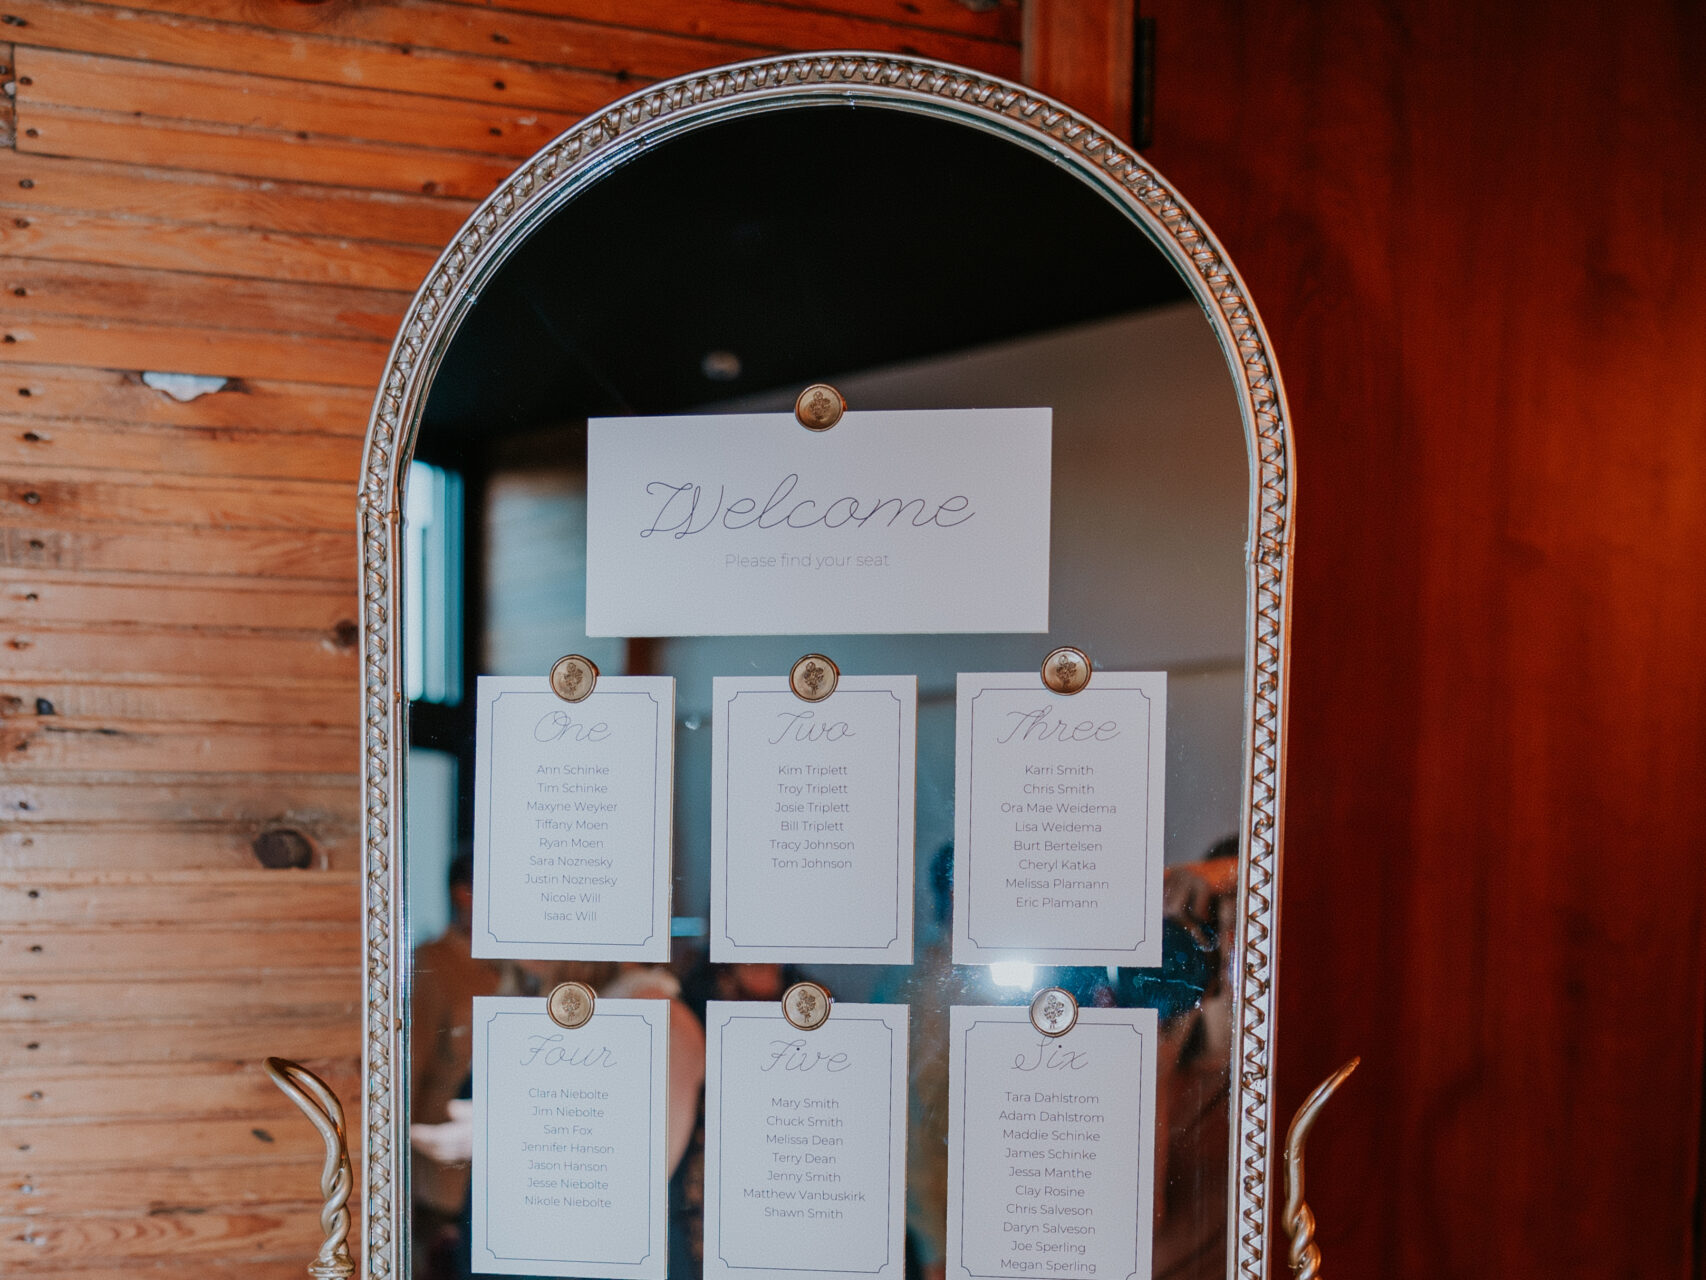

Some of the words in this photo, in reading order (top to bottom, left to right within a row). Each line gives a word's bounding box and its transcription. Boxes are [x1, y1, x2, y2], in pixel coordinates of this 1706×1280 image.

[640, 473, 975, 539] Welcome
[725, 553, 776, 568] Please
[781, 553, 812, 568] find
[815, 554, 852, 570] your
[856, 553, 889, 567] seat
[534, 710, 612, 742] One
[769, 710, 856, 744] Two
[997, 705, 1120, 744] Three
[537, 765, 560, 775] Ann
[564, 764, 609, 776] Schinke
[778, 765, 802, 776] Kim
[805, 764, 848, 778] Triplett
[1025, 765, 1053, 776] Karri
[1057, 764, 1094, 776] Smith
[778, 784, 802, 796] Troy
[806, 784, 848, 796] Triplett
[1024, 784, 1054, 795] Chris
[1058, 784, 1094, 794] Smith
[527, 802, 571, 814] Maxyne
[574, 802, 617, 814] Weyker
[776, 802, 804, 813] Josie
[808, 802, 850, 815] Triplett
[1001, 803, 1023, 813] Ora
[1027, 803, 1053, 813] Mae
[1057, 802, 1116, 814] Weidema
[536, 820, 572, 832] Tiffany
[576, 820, 608, 830] Moen
[781, 821, 798, 832] Bill
[802, 821, 844, 834] Triplett
[1015, 822, 1037, 833] Lisa
[1042, 821, 1102, 833] Weidema
[540, 838, 568, 850] Ryan
[572, 838, 604, 849] Moen
[770, 840, 800, 852] Tracy
[804, 840, 854, 850] Johnson
[530, 856, 554, 866] Sara
[558, 856, 612, 870] Noznesky
[772, 858, 798, 869] Tom
[802, 858, 852, 870] Johnson
[1019, 859, 1058, 872] Cheryl
[1061, 859, 1096, 871] Katka
[525, 874, 558, 885] Justin
[562, 874, 618, 888] Noznesky
[1006, 878, 1049, 889] Melissa
[1054, 878, 1109, 890] Plamann
[541, 892, 576, 904] Nicole
[580, 892, 600, 903] Will
[1016, 897, 1038, 908] Eric
[1043, 897, 1098, 909] Plamann
[520, 1034, 617, 1069] Four
[761, 1039, 852, 1073] Five
[1011, 1036, 1088, 1071] Six
[772, 1097, 800, 1110] Mary
[804, 1098, 839, 1109] Smith
[1005, 1091, 1031, 1103] Tara
[1034, 1092, 1099, 1104] Dahlstrom
[767, 1116, 804, 1127] Chuck
[808, 1116, 843, 1127] Smith
[999, 1110, 1036, 1122] Adam
[1040, 1111, 1105, 1123] Dahlstrom
[544, 1125, 569, 1135] Sam
[573, 1125, 592, 1135] Fox
[1003, 1130, 1048, 1141] Maddie
[1052, 1130, 1101, 1142] Schinke
[766, 1134, 808, 1145] Melissa
[812, 1135, 843, 1146] Dean
[521, 1142, 567, 1153] Jennifer
[570, 1143, 614, 1154] Hanson
[1005, 1148, 1045, 1160] James
[1048, 1149, 1097, 1161] Schinke
[528, 1160, 560, 1171] Jason
[564, 1161, 607, 1172] Hanson
[767, 1170, 802, 1183] Jenny
[805, 1171, 841, 1183] Smith
[527, 1178, 557, 1189] Jesse
[561, 1179, 608, 1190] Niebolte
[744, 1188, 796, 1200] Matthew
[799, 1189, 865, 1202] Vanbuskirk
[1015, 1185, 1041, 1199] Clay
[1044, 1186, 1085, 1198] Rosine
[764, 1207, 804, 1218] Shawn
[808, 1208, 843, 1219] Smith
[1006, 1204, 1037, 1215] Chris
[1041, 1204, 1093, 1216] Salveson
[1003, 1222, 1039, 1235] Daryn
[1043, 1223, 1096, 1235] Salveson
[1011, 1240, 1033, 1252] Joe
[1036, 1241, 1086, 1255] Sperling
[1001, 1259, 1042, 1272] Megan
[1046, 1260, 1096, 1274] Sperling
